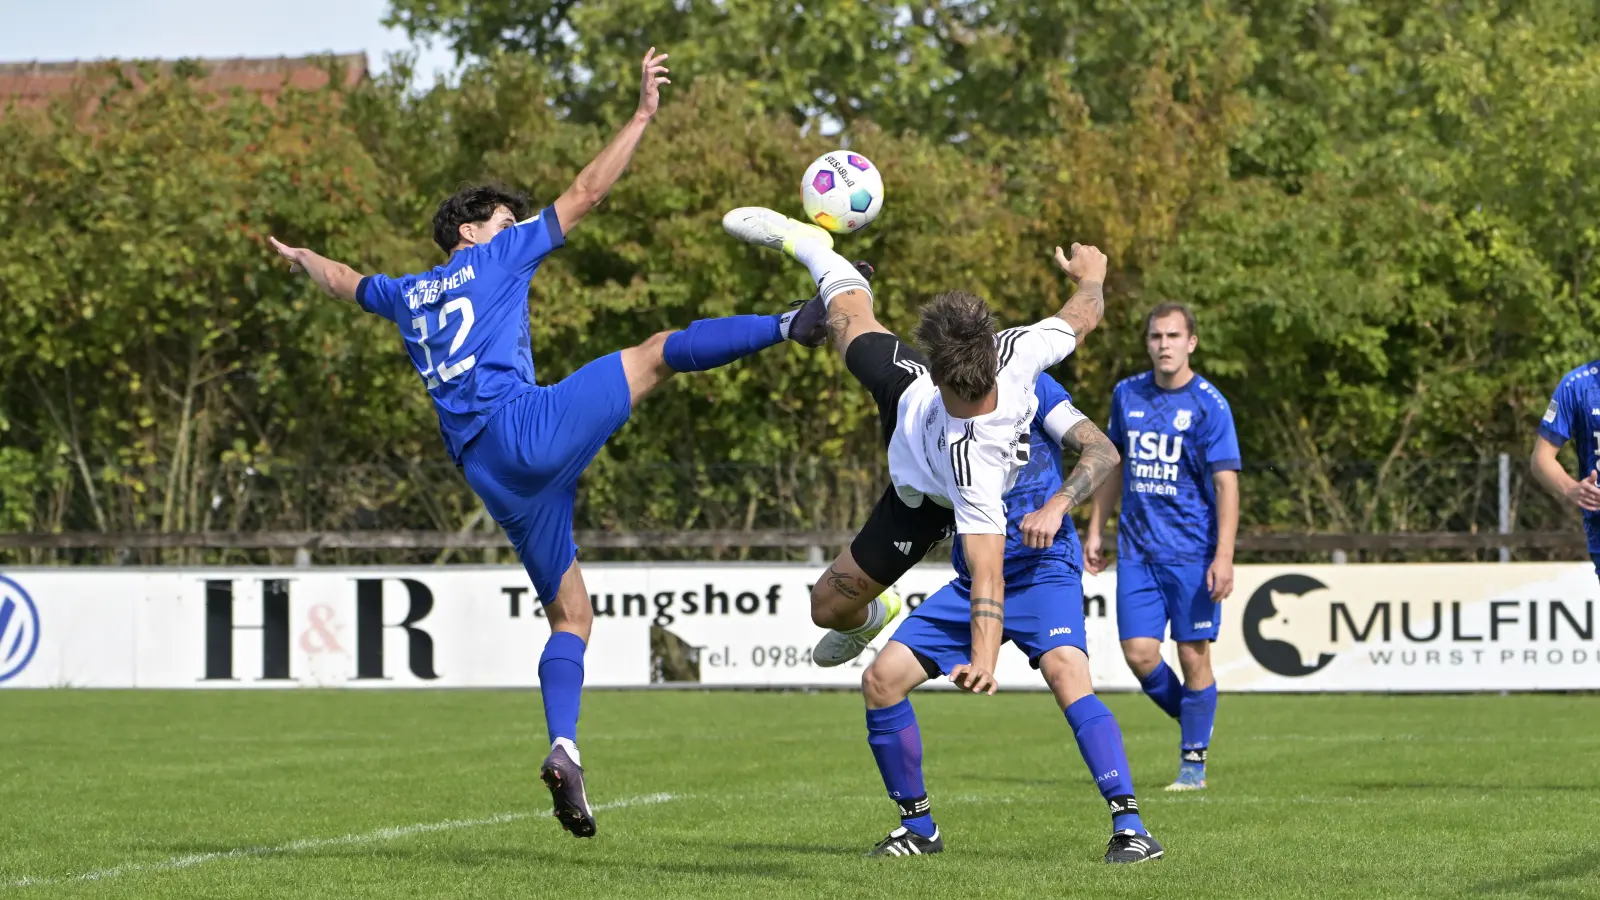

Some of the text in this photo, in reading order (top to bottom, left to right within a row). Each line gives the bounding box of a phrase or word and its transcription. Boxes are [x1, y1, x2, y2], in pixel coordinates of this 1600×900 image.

[412, 296, 476, 389] 12
[501, 583, 781, 626] Tungshof
[1049, 627, 1072, 637] JAKO
[751, 645, 813, 667] 0984
[1368, 649, 1485, 666] WURST
[1095, 769, 1119, 784] JAKO
